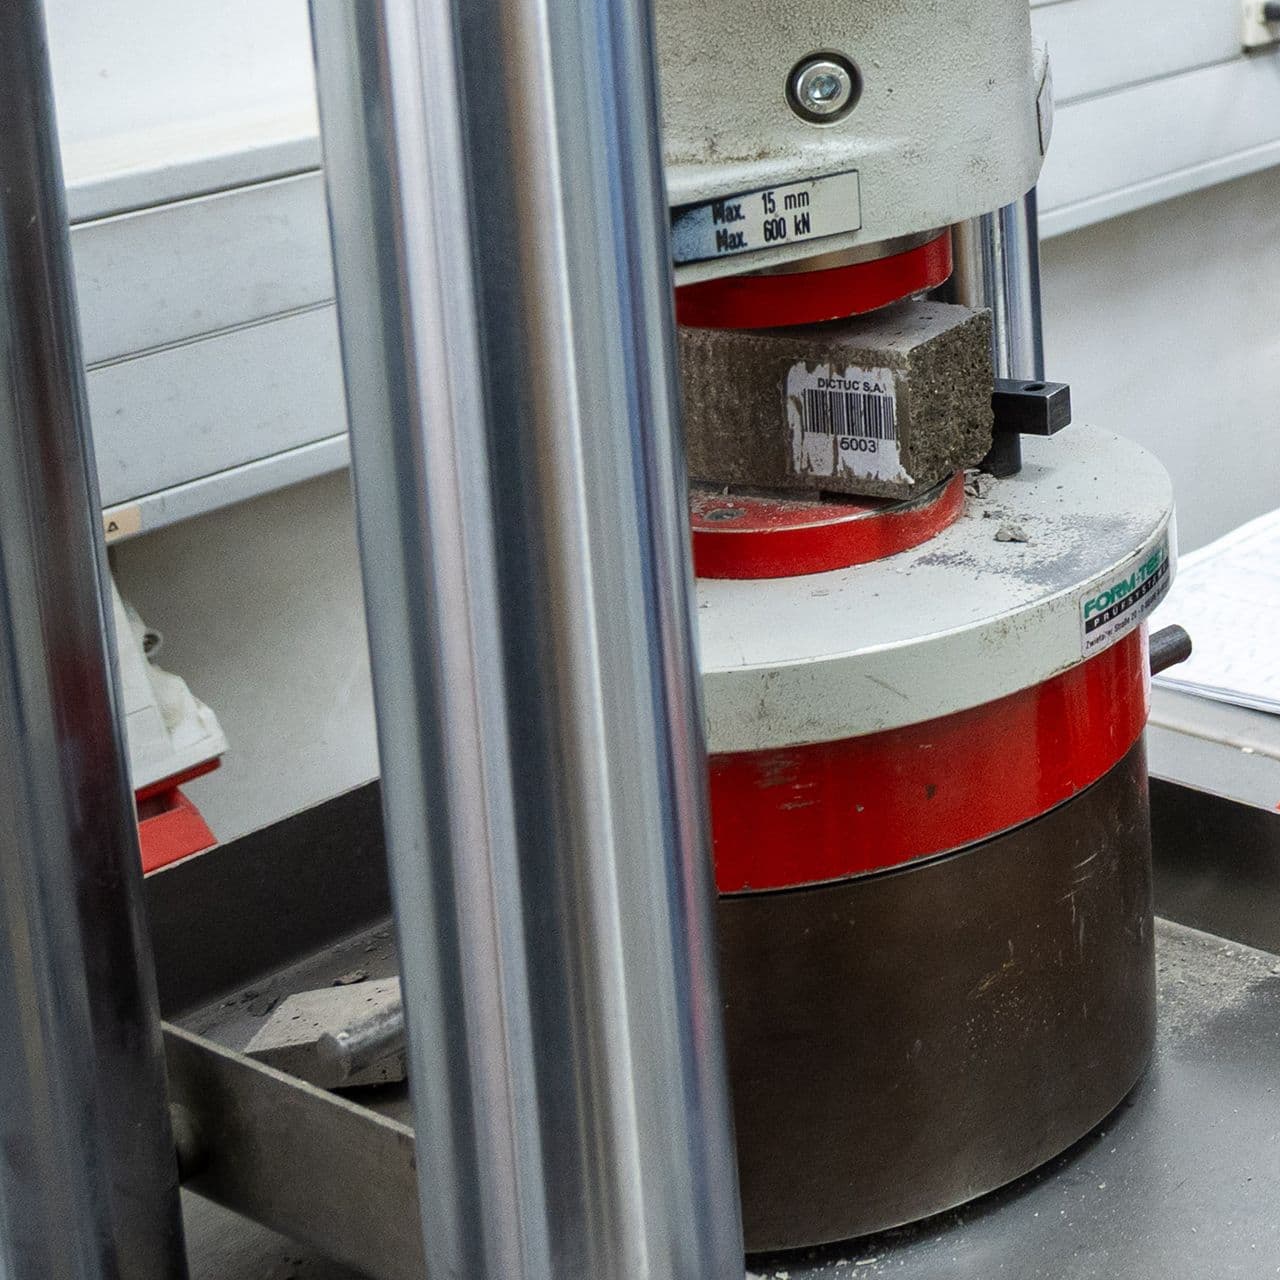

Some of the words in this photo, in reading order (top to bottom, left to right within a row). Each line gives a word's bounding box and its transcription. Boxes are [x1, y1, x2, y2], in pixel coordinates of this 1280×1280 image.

[711, 202, 746, 225] Max.
[762, 191, 776, 214] 15
[784, 191, 810, 211] mm
[715, 228, 749, 253] Max.
[763, 217, 787, 242] 600
[794, 211, 811, 237] kN
[817, 378, 860, 391] DICTUC
[862, 381, 884, 394] S.A.
